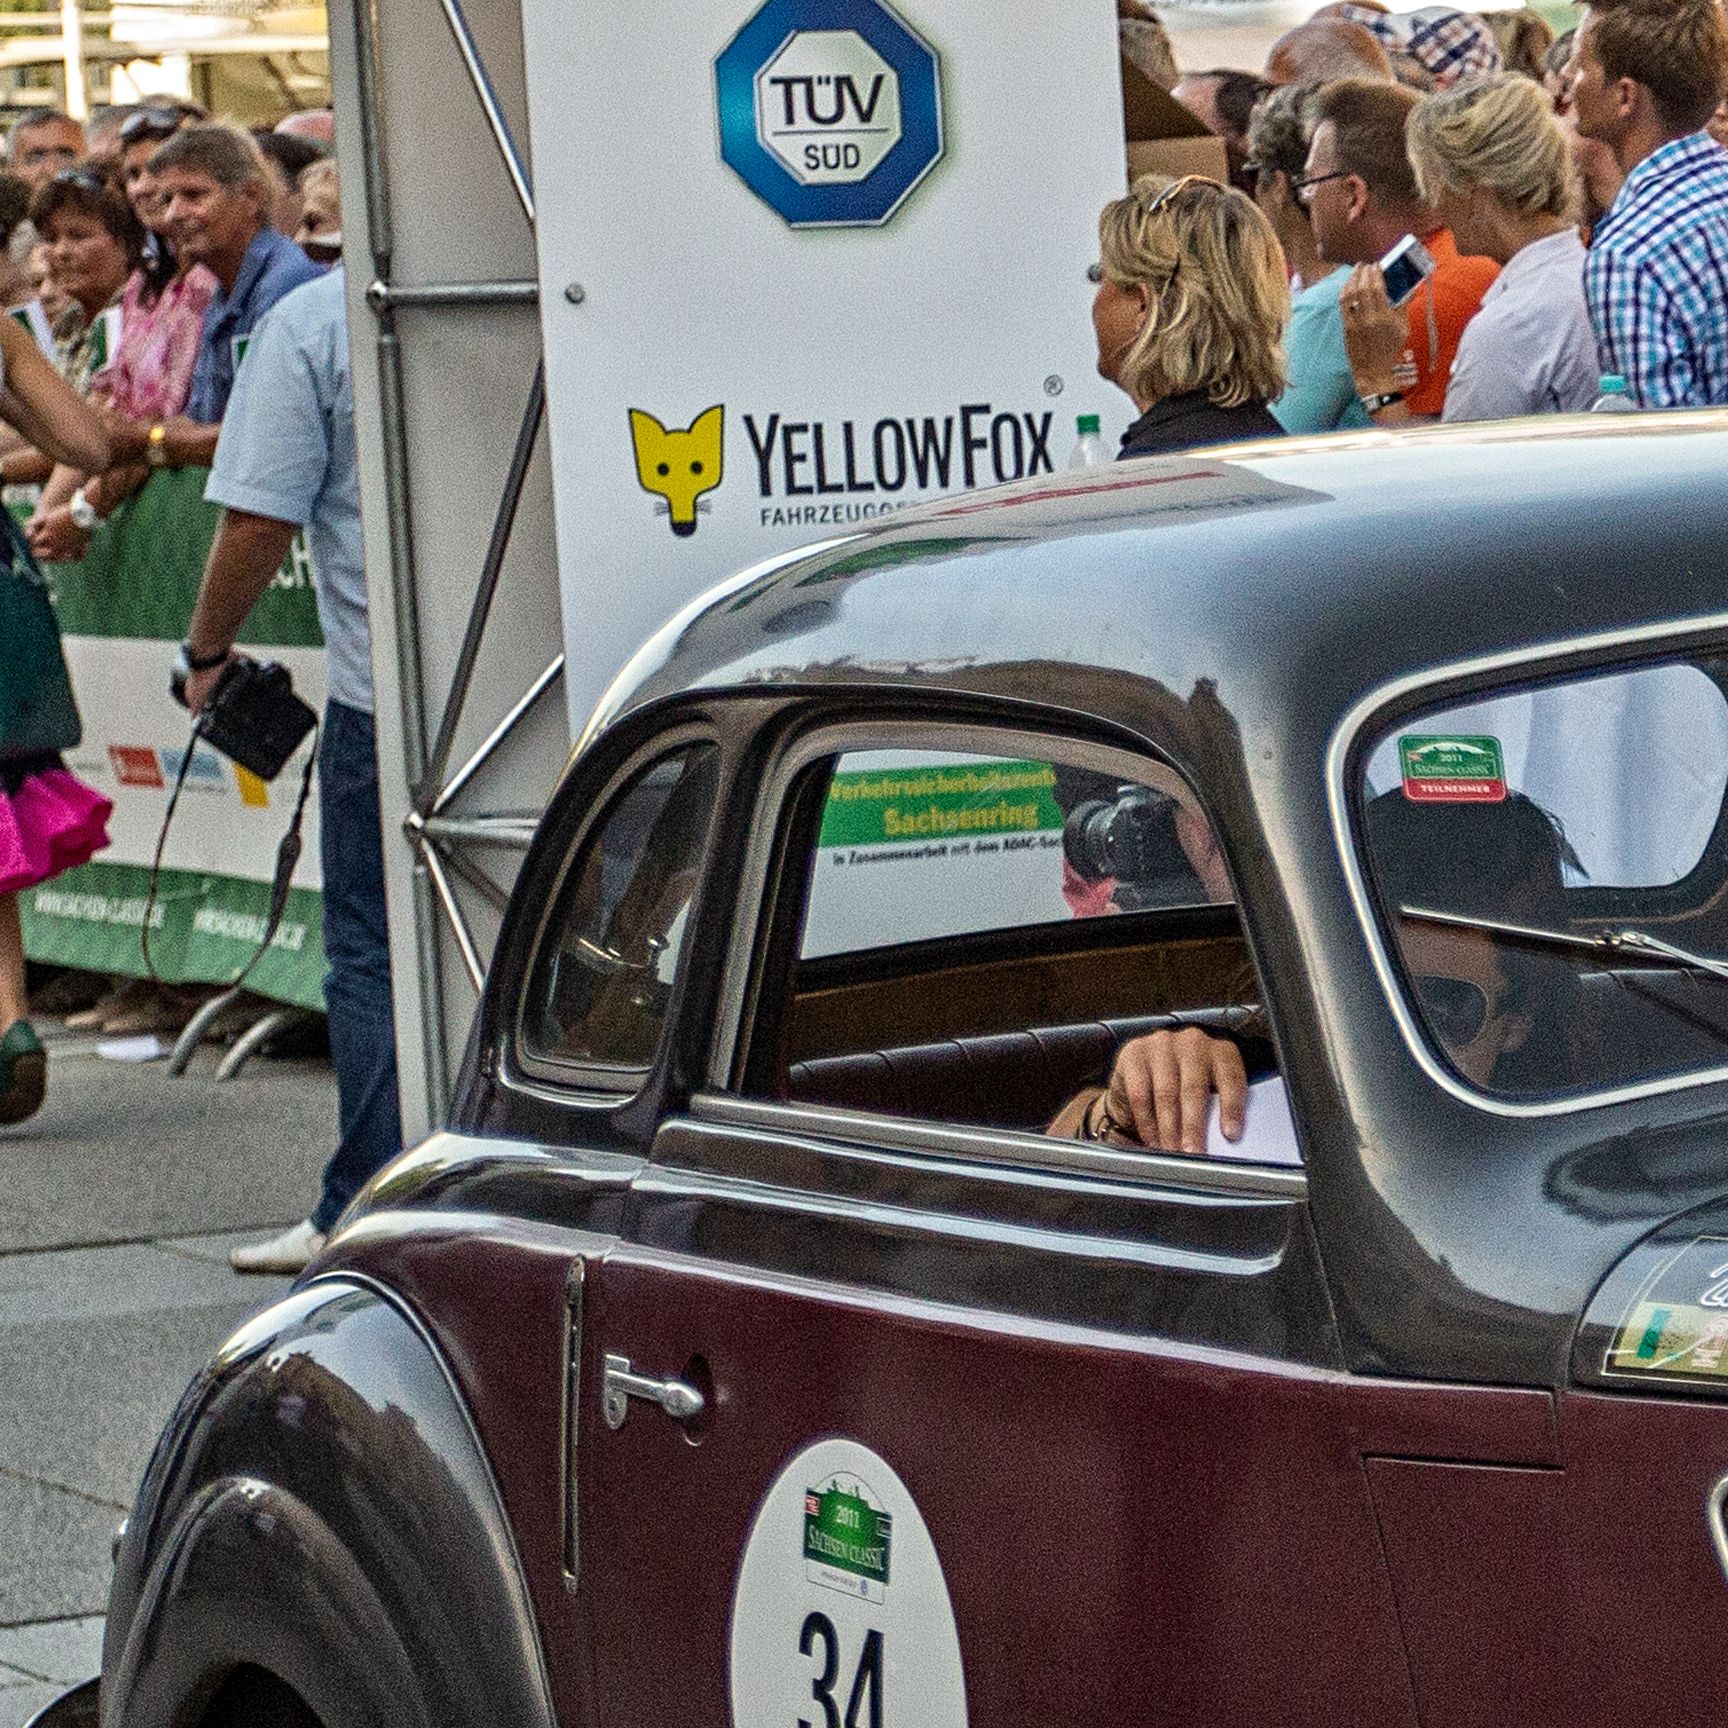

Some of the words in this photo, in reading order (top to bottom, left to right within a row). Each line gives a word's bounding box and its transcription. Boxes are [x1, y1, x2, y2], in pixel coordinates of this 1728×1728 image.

[770, 74, 884, 125] TÜV
[804, 143, 861, 171] SÜD
[1421, 784, 1490, 793] TEILNEHMER
